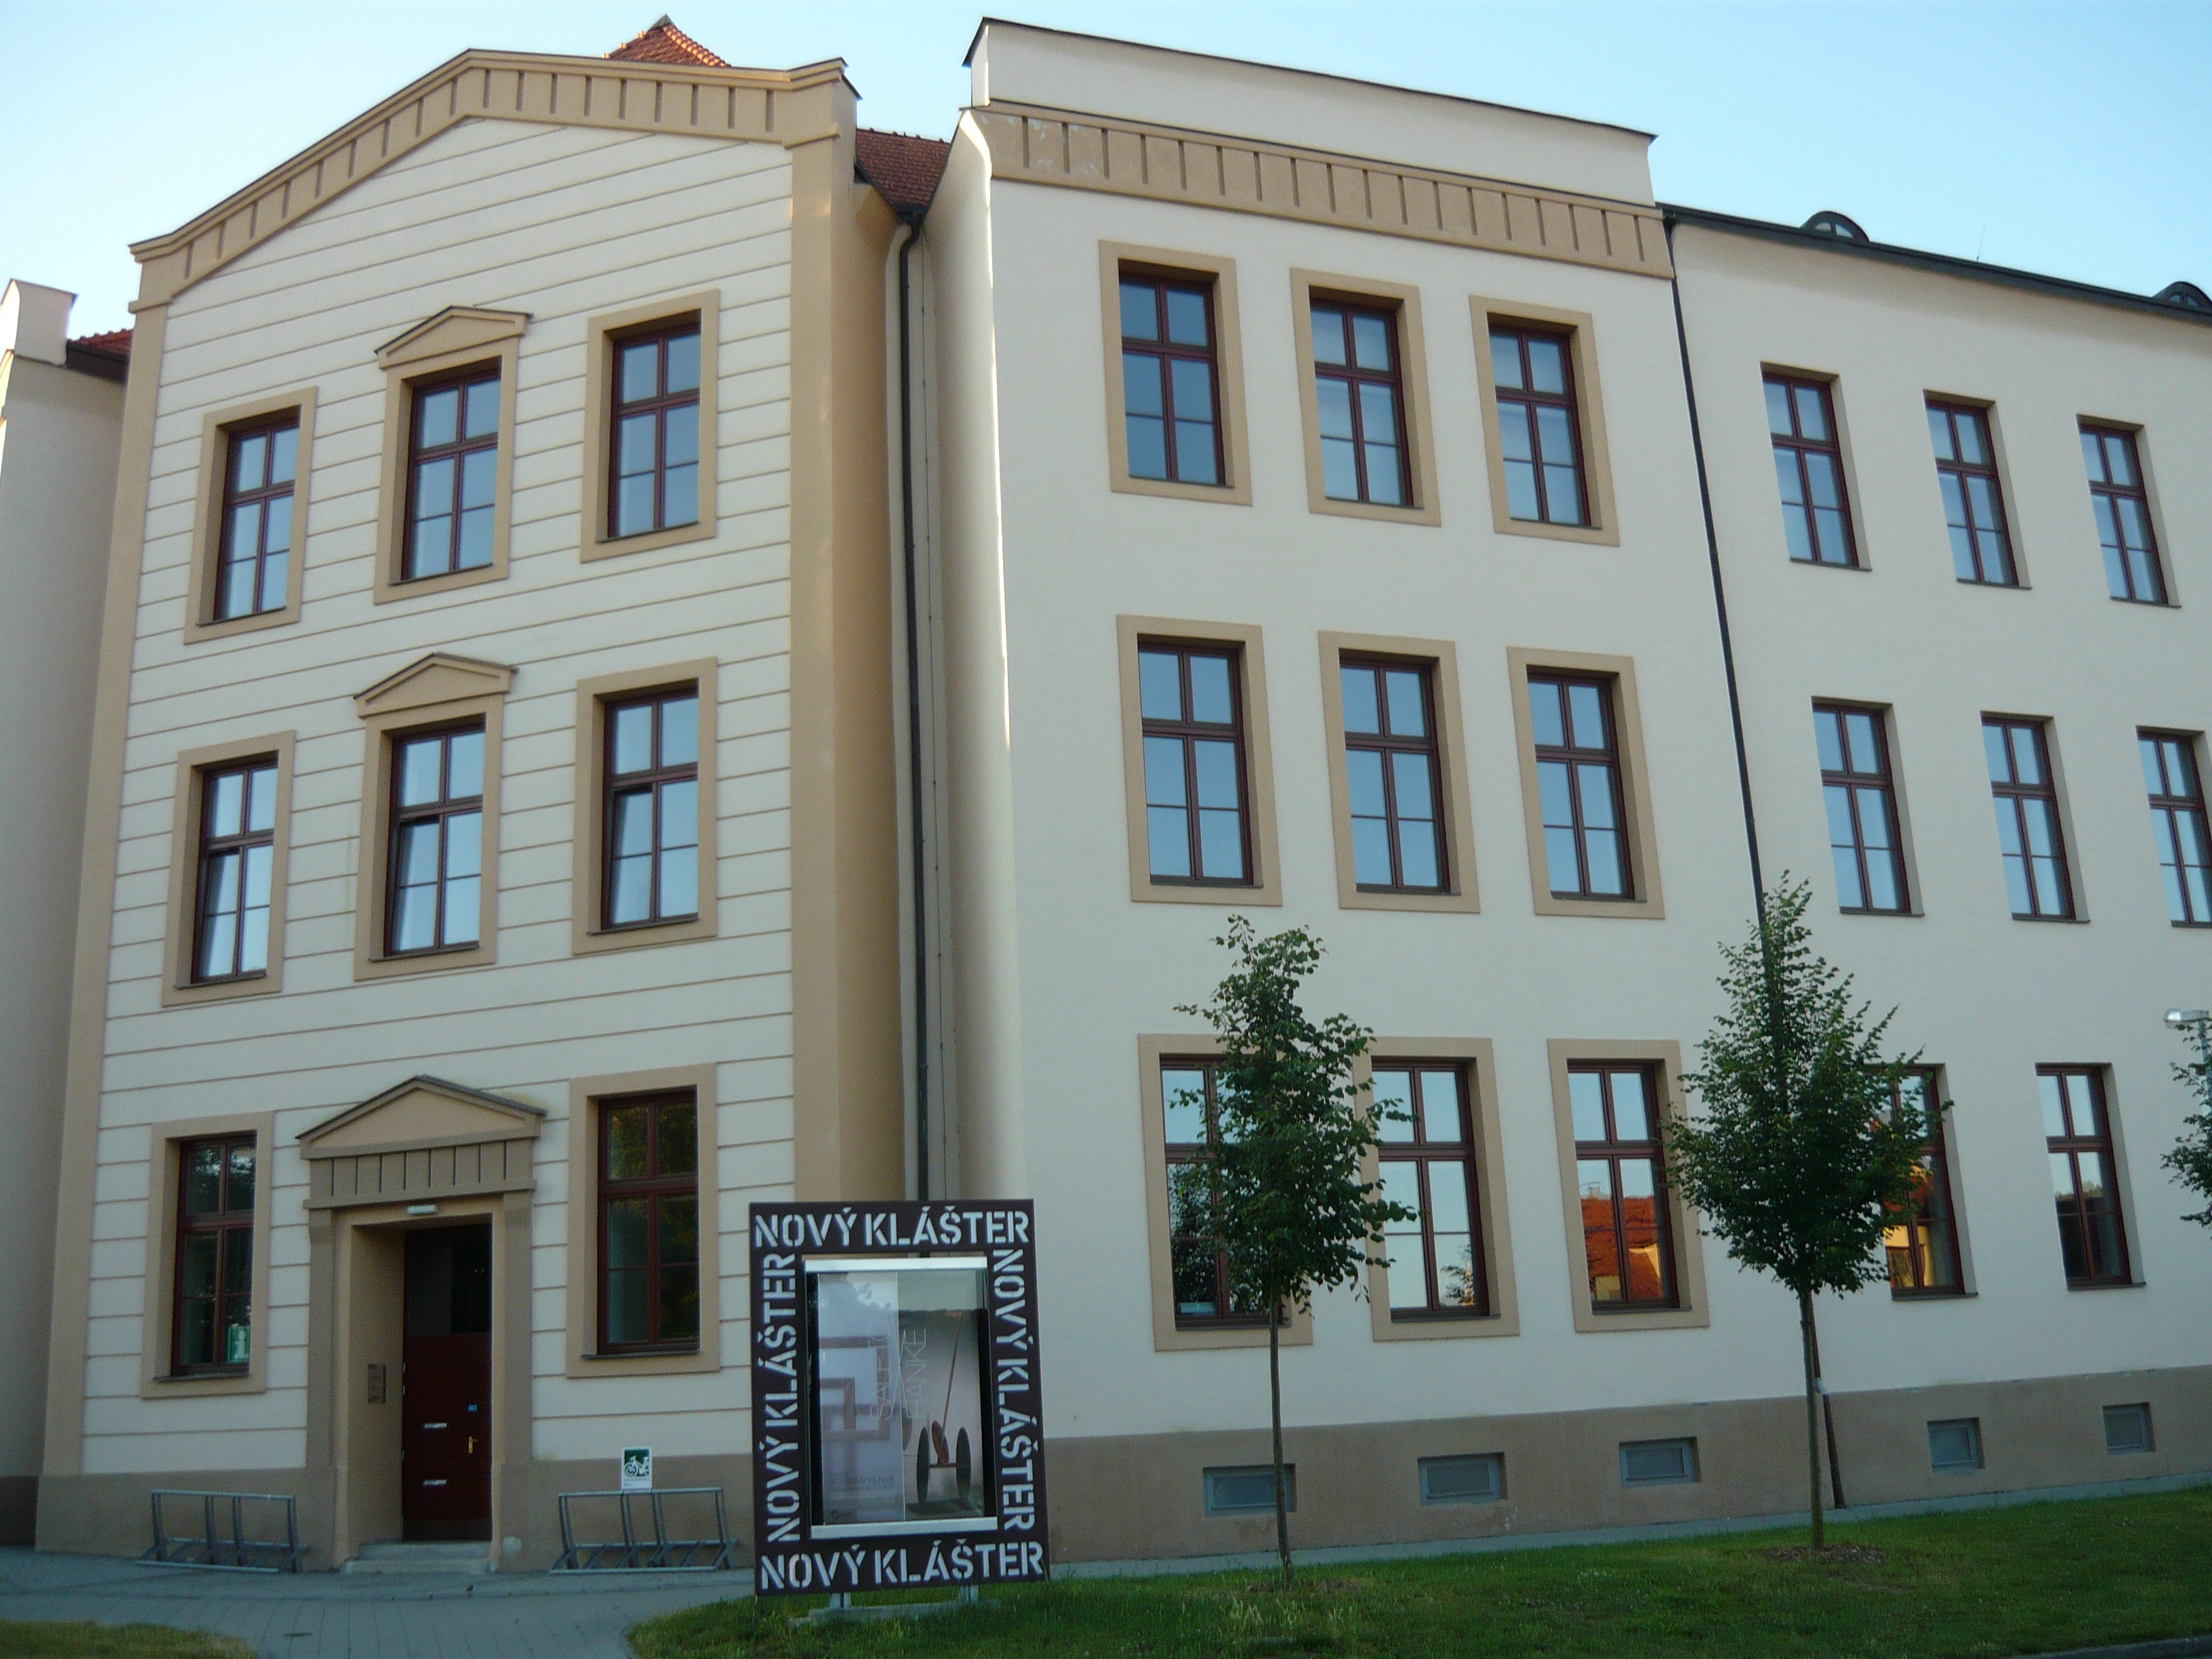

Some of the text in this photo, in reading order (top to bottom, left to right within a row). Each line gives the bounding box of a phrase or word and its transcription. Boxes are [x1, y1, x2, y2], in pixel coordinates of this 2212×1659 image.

[755, 1205, 1029, 1248] NOVÝ KLÁŠTER
[758, 1254, 800, 1542] NOVÝ KLÁŠTER
[992, 1248, 1038, 1531] NOVÝ KLÁŠTER
[762, 1539, 1044, 1589] NOVÝ KLÁŠTER
